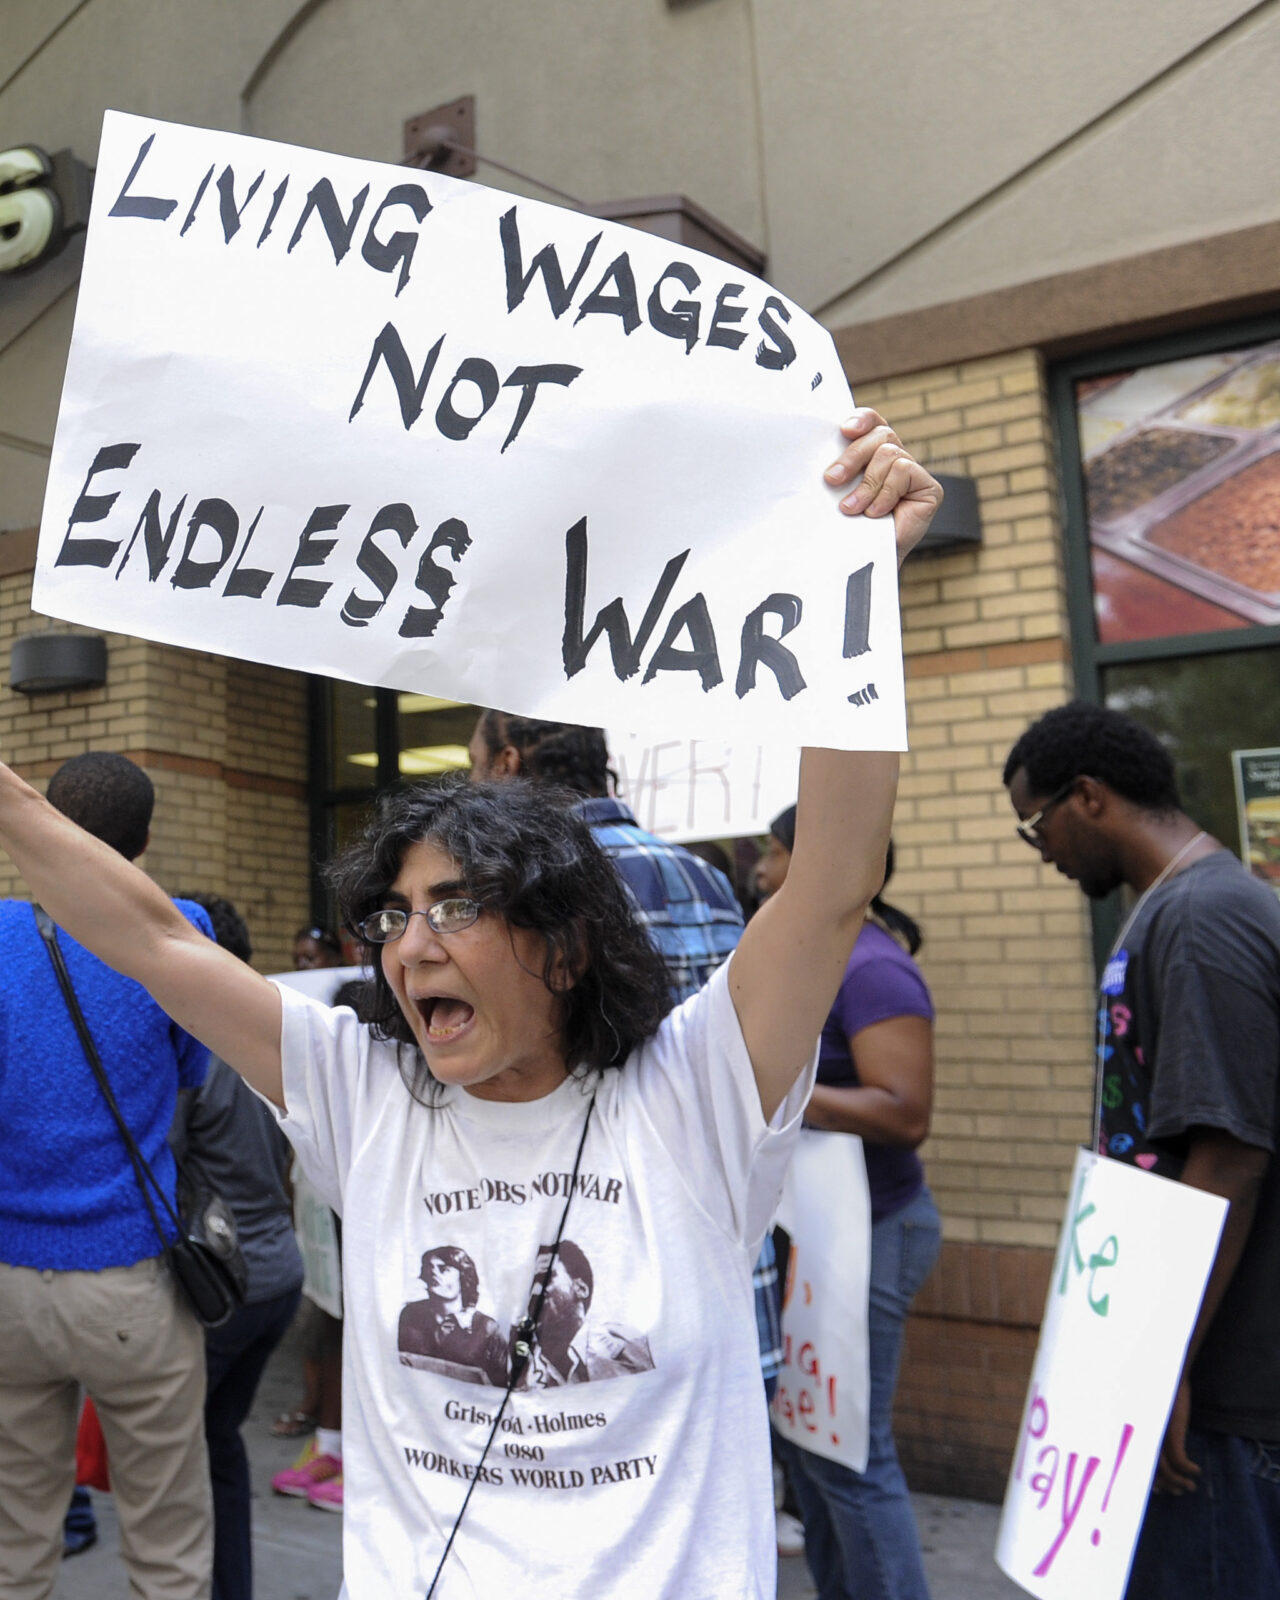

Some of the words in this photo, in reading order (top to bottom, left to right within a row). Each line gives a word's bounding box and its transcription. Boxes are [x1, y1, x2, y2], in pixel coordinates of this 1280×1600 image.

[108, 133, 433, 297] LIVING
[499, 205, 823, 391] WAGES,
[348, 322, 585, 454] NOT
[54, 442, 471, 638] ENDLESS
[423, 1187, 482, 1217] VOTE
[480, 1177, 527, 1206] OBS
[403, 1447, 505, 1487] WORKERS
[509, 1468, 585, 1490] WORLD
[591, 1454, 659, 1487] PARTY
[503, 1443, 545, 1463] 1980
